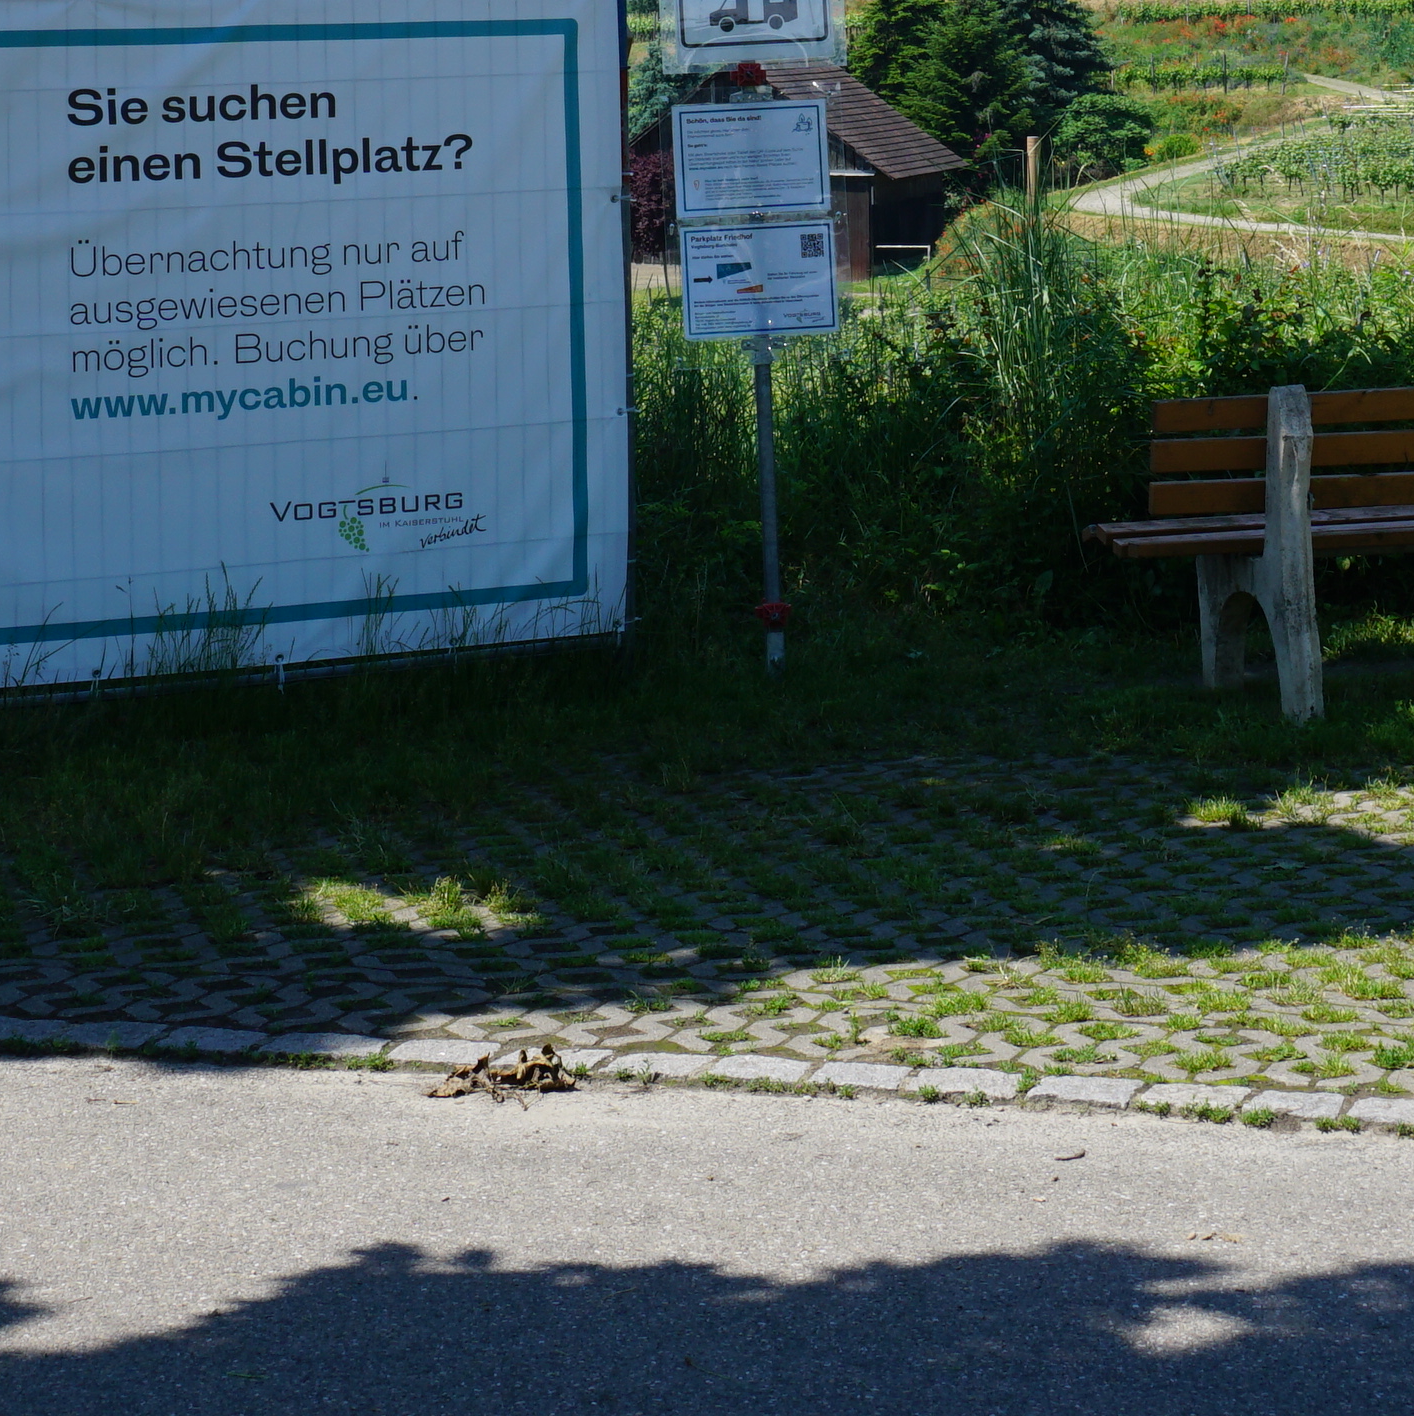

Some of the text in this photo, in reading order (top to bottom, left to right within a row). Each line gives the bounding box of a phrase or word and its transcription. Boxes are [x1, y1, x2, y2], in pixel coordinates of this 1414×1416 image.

[67, 84, 337, 126] Sie suchen
[686, 117, 708, 125] Schön,
[68, 133, 474, 185] einen Stellplatz?
[69, 230, 465, 279] Übernachtung nur auf
[690, 233, 753, 243] Parkplatz Friedhof
[69, 280, 486, 330] ausgewiesenen Plätzen
[71, 325, 484, 378] möglich. Buchung über
[70, 375, 419, 421] www.mycabin.eu.
[269, 492, 463, 522] VOGTSBURG
[379, 520, 391, 529] IM
[420, 513, 487, 549] verbindet
